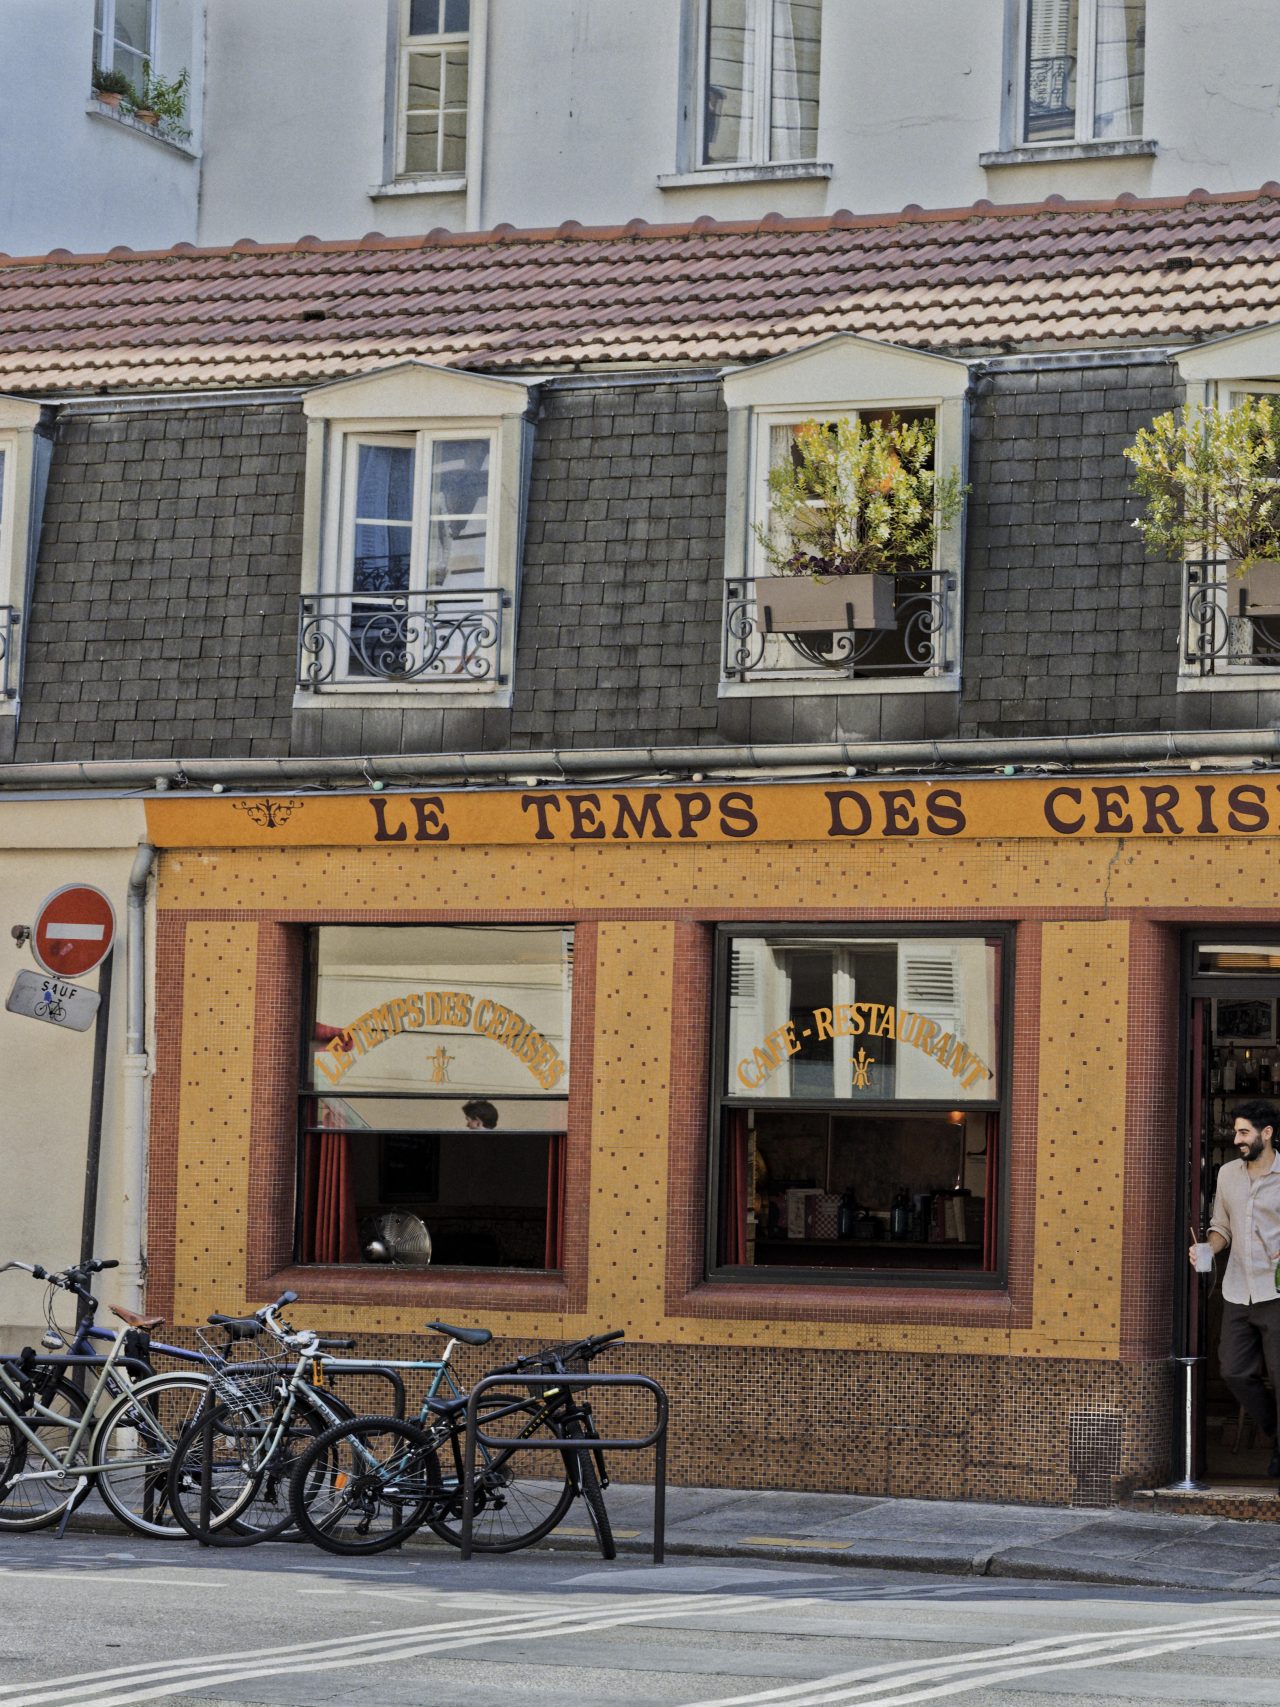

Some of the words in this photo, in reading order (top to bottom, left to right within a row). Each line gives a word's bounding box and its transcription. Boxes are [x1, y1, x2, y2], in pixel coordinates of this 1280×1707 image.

[369, 797, 449, 841] LE
[522, 791, 759, 840] TEMPS
[826, 789, 967, 836] DES
[41, 981, 77, 1000] SAUF
[314, 1034, 355, 1085] LE
[343, 993, 423, 1056] TEMPS
[424, 991, 474, 1027] DES
[472, 999, 566, 1090] CERISES
